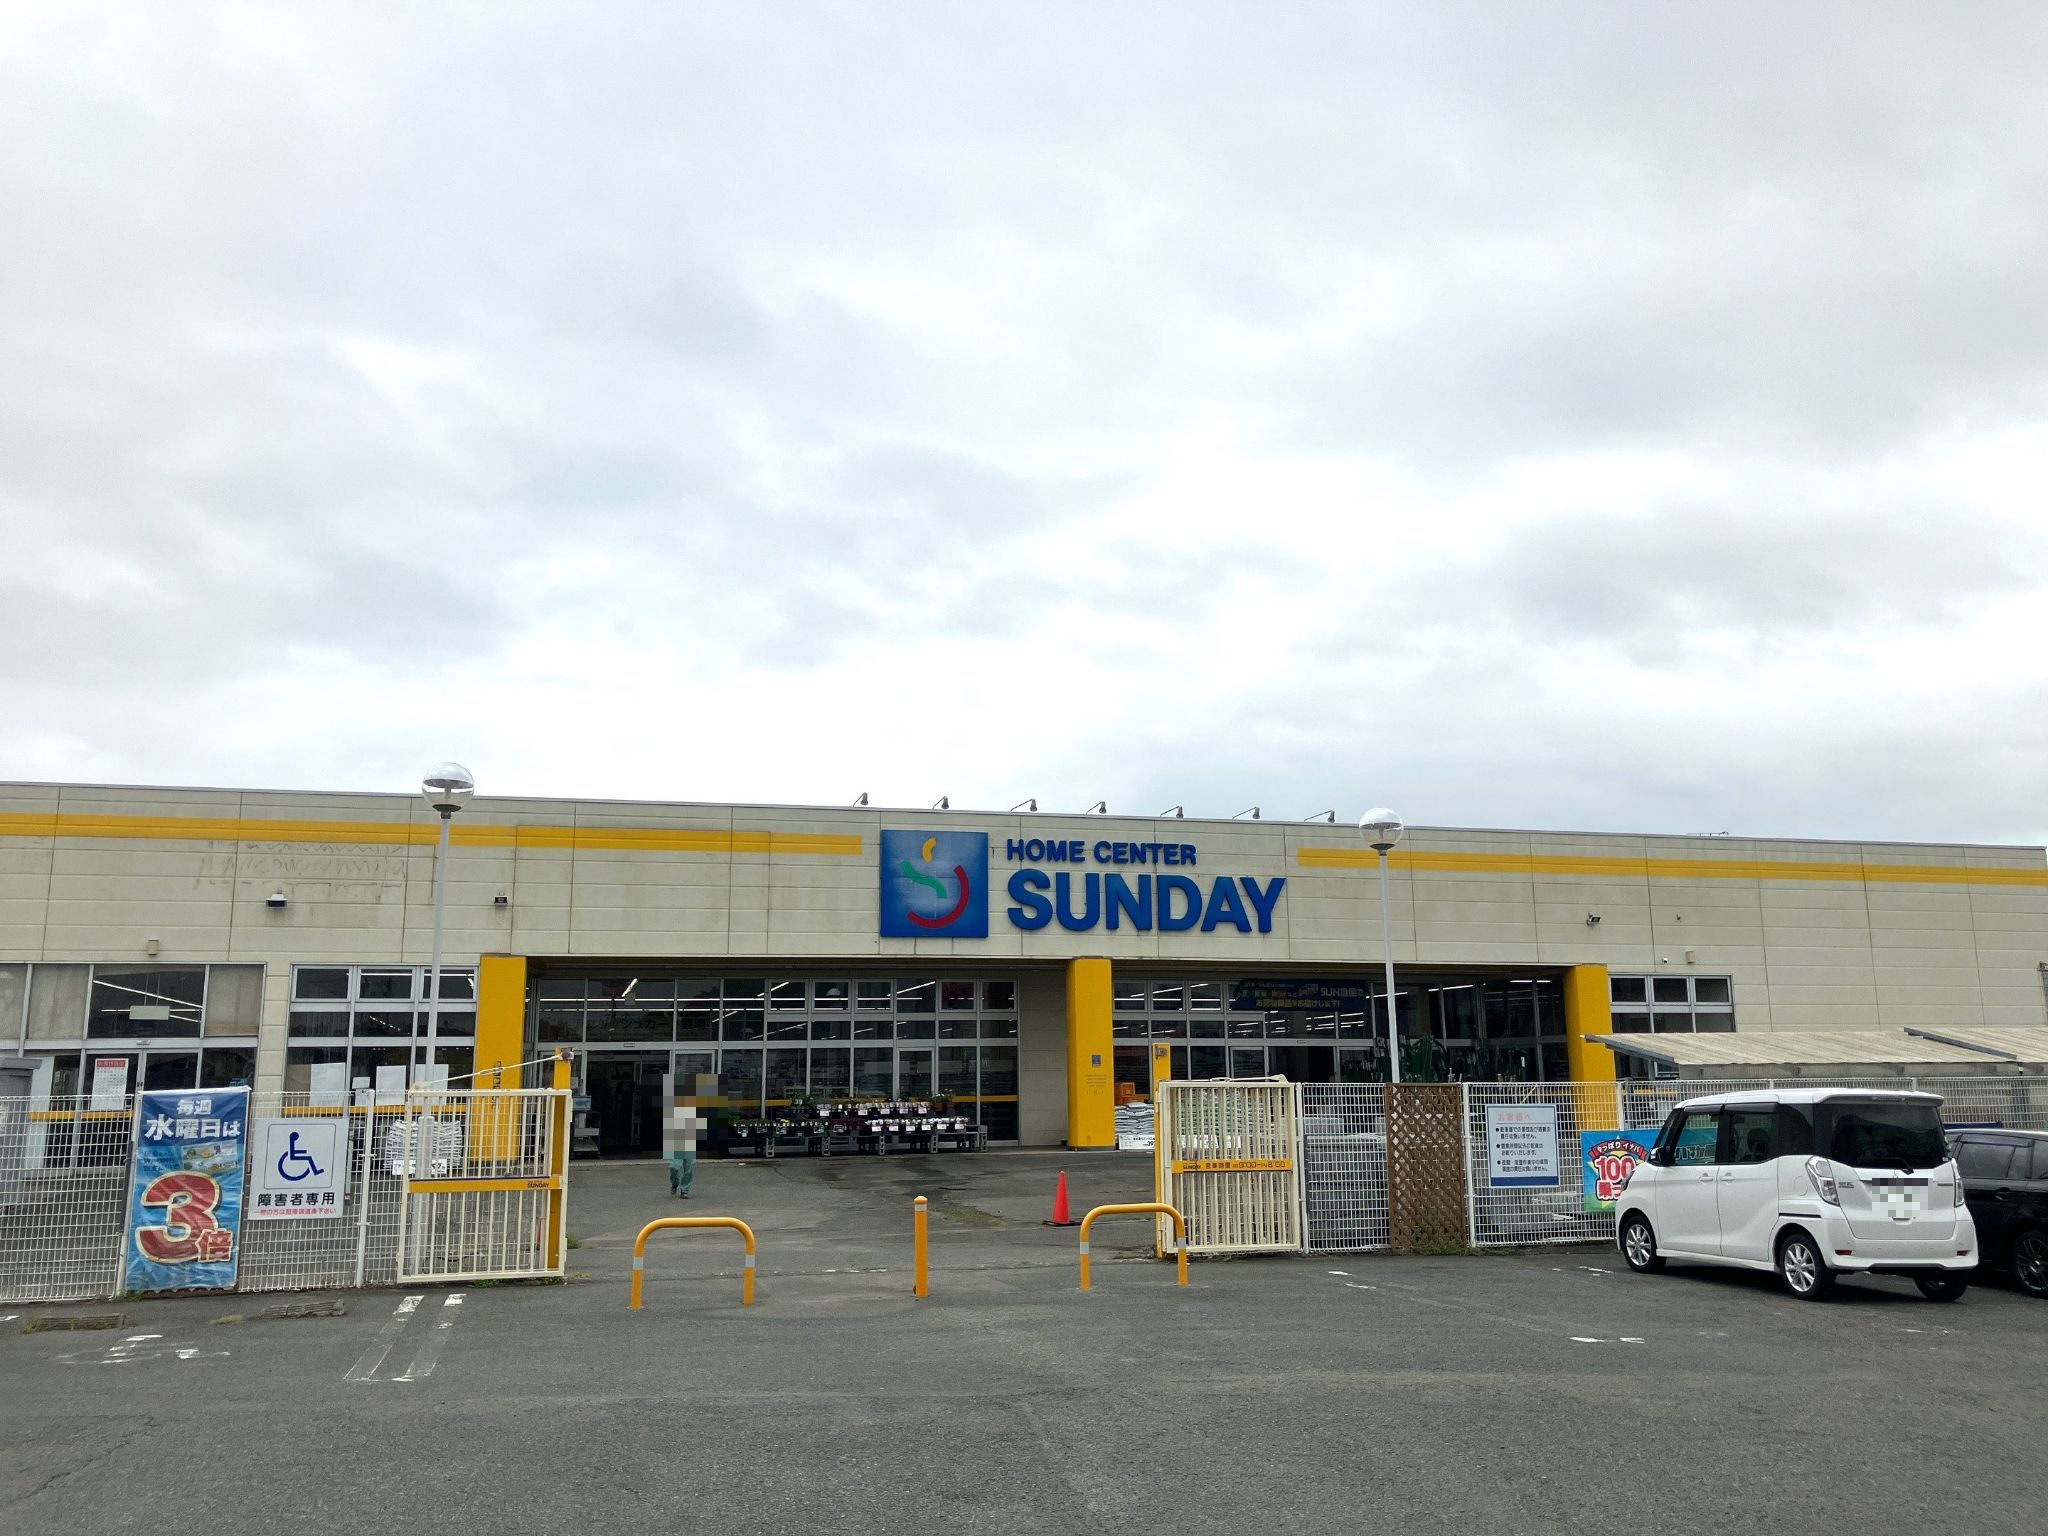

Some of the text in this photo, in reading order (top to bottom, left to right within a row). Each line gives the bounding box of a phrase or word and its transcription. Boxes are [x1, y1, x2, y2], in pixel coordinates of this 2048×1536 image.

[1007, 838, 1197, 865] HOME CENTER
[1007, 868, 1286, 933] SUNDAY
[177, 1099, 212, 1115] 毎週
[144, 1113, 241, 1141] 水曜日は
[257, 1191, 335, 1207] 障害者専用
[136, 1170, 233, 1263] 3倍
